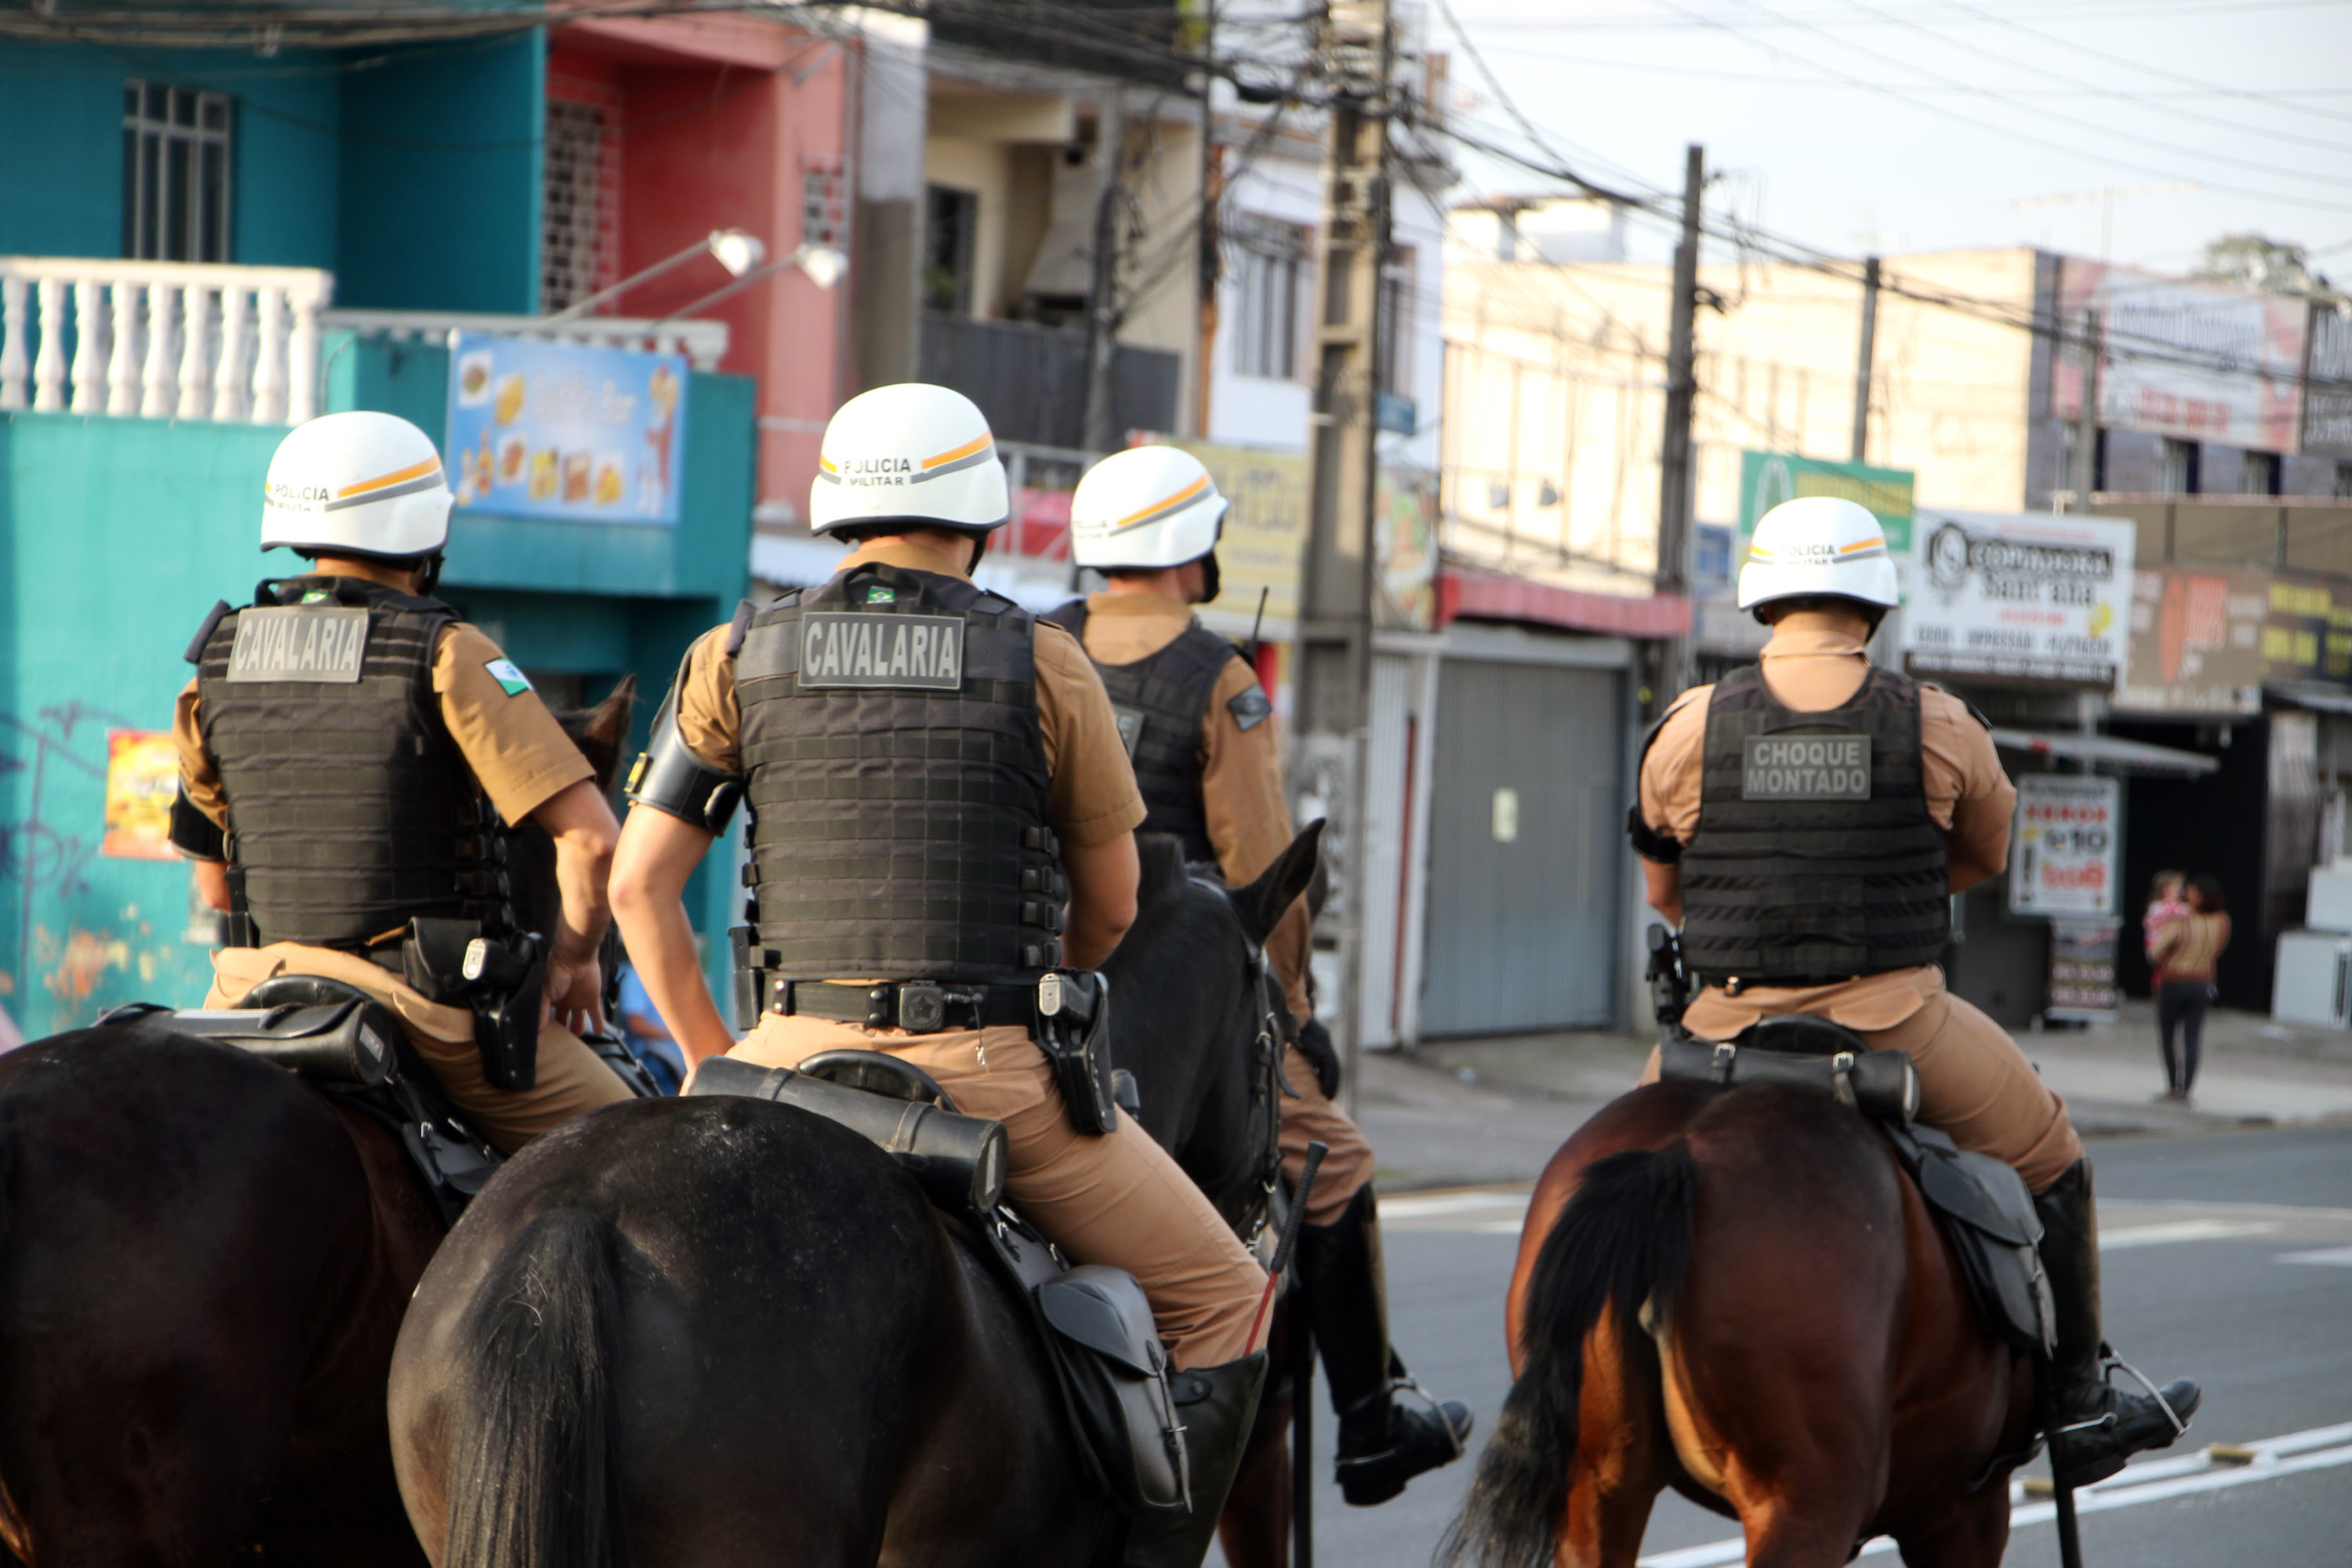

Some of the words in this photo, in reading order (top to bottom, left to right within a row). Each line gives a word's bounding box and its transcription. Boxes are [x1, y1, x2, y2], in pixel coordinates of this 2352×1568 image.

[844, 458, 911, 474] POLICIA
[275, 485, 329, 502] POLICIA
[850, 477, 903, 486] MILITAR
[237, 617, 359, 671] CAVALARIA
[805, 622, 956, 678] CAVALARIA
[1755, 742, 1861, 767] CHOQUE
[1747, 768, 1867, 794] MONTADO
